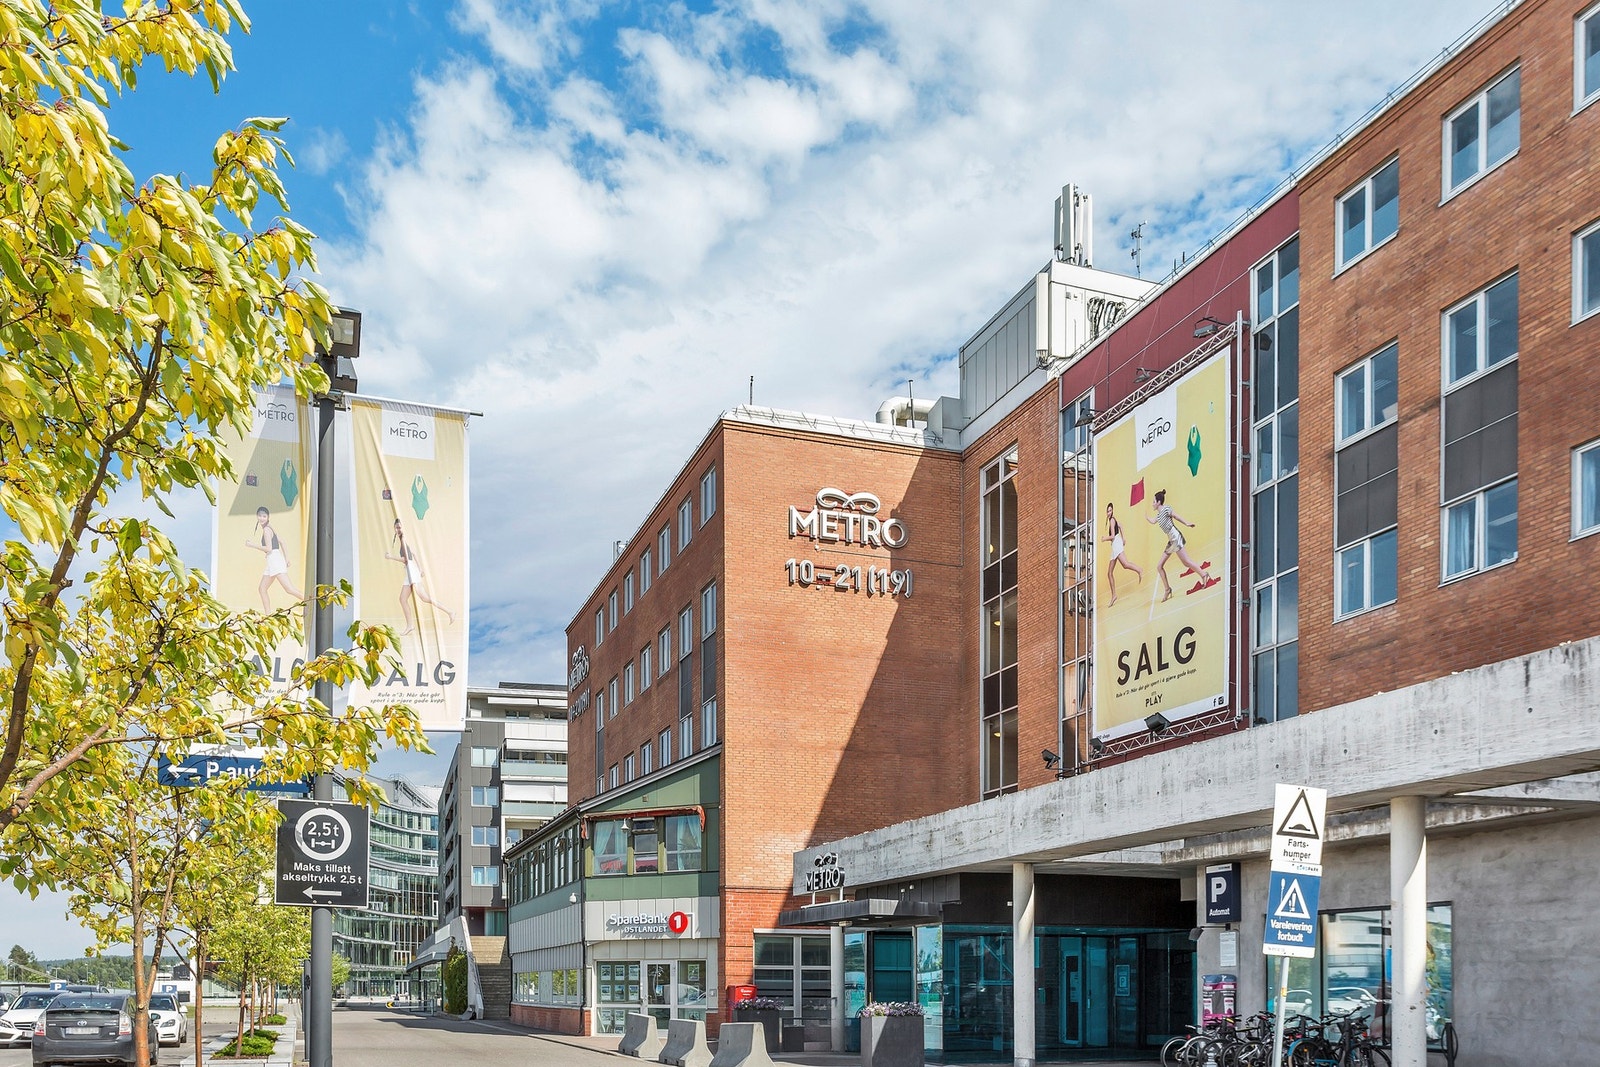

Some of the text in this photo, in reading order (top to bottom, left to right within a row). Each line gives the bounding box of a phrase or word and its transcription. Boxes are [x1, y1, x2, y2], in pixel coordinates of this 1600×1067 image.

[258, 409, 295, 422] METRO
[390, 427, 428, 440] METRO
[1142, 421, 1171, 448] METRO
[788, 504, 909, 549] METRO
[867, 564, 913, 599] (19)
[1117, 626, 1196, 686] SALG
[1145, 694, 1163, 708] PLAY
[206, 761, 302, 784] P-aut
[1288, 838, 1309, 848] Farts-
[1283, 849, 1312, 862] humper
[294, 862, 351, 873] Maks tillatt
[282, 872, 336, 884] akseltrykk
[806, 867, 842, 891] METRO
[1211, 876, 1227, 903] P
[610, 912, 668, 926] SpareBank
[1209, 908, 1230, 916] Automat
[1270, 919, 1312, 934] Varelevering
[1278, 930, 1304, 942] forbudt
